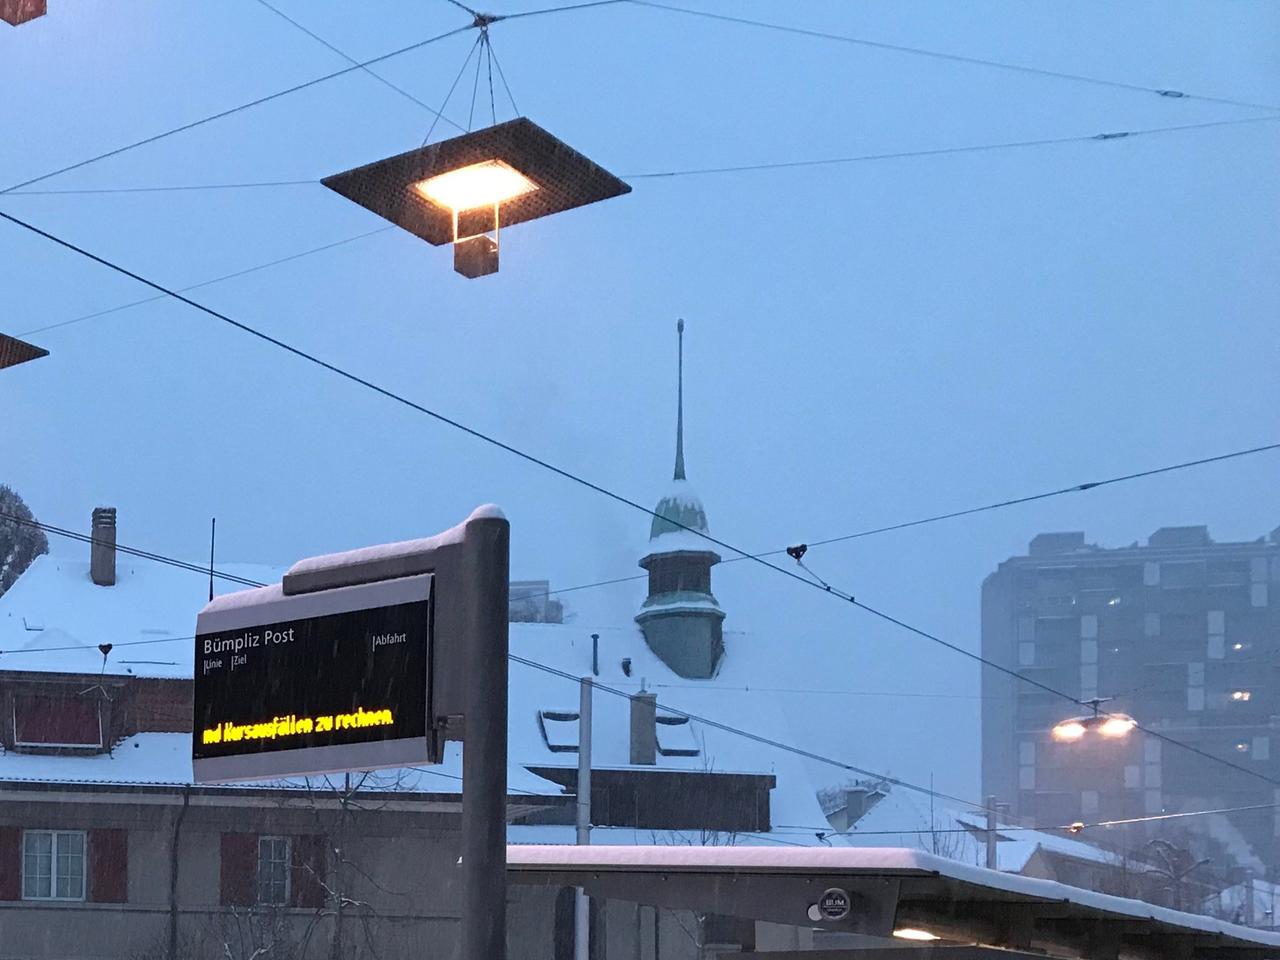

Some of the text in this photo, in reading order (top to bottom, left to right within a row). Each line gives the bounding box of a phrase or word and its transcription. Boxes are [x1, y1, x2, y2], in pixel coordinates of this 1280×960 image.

[204, 628, 295, 653] Bümpliz Post
[375, 632, 406, 646] Abfahrt
[233, 654, 247, 665] Ziel
[315, 715, 333, 731] zu
